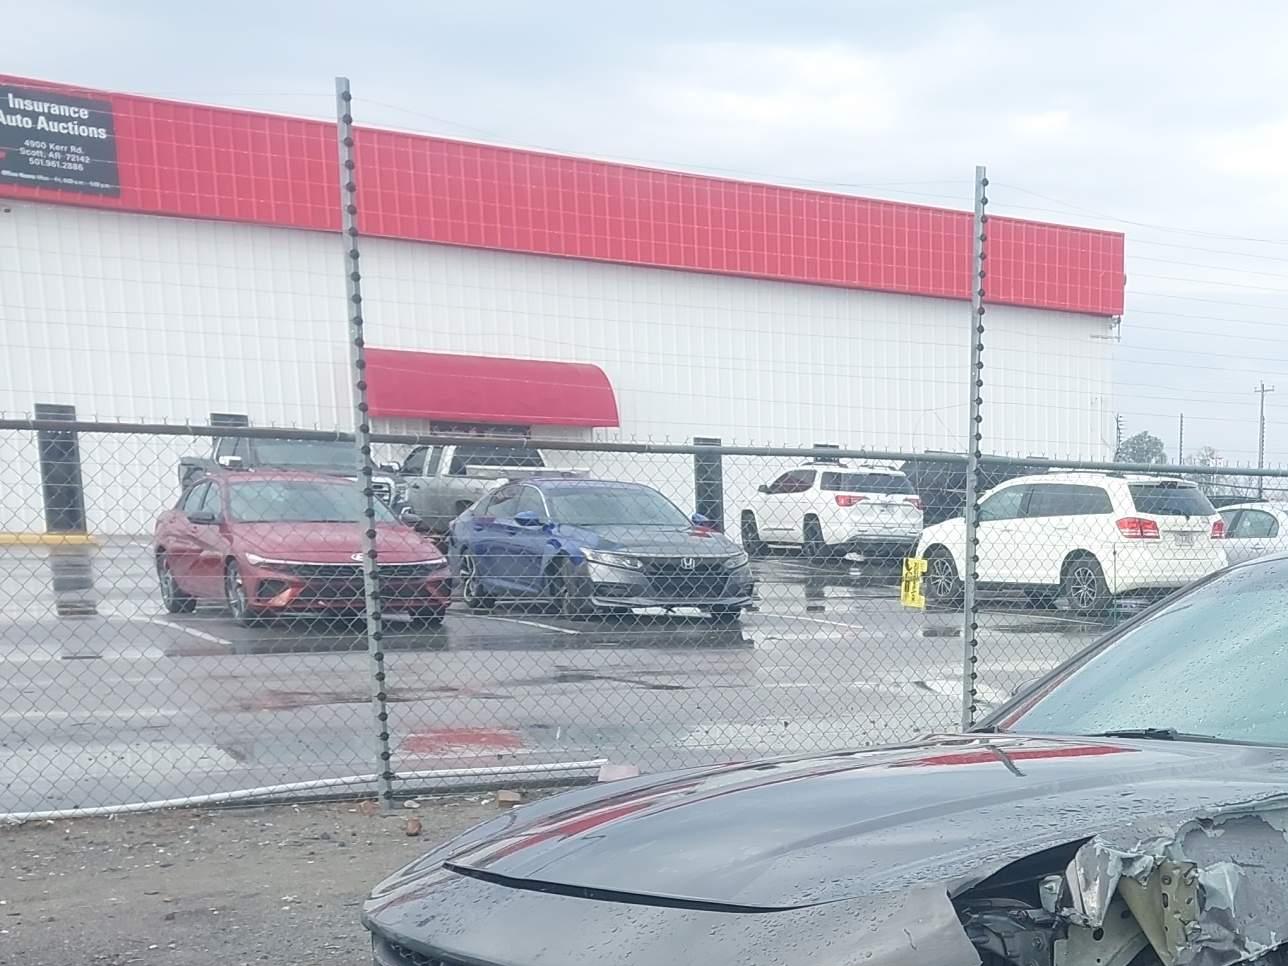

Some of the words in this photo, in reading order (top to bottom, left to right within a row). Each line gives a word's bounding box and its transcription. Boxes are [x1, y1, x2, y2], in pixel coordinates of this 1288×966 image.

[8, 93, 89, 119] Insurance
[0, 110, 32, 129] Auto
[37, 116, 107, 139] Auctions
[48, 142, 68, 152] Kerr
[48, 151, 61, 160] AR
